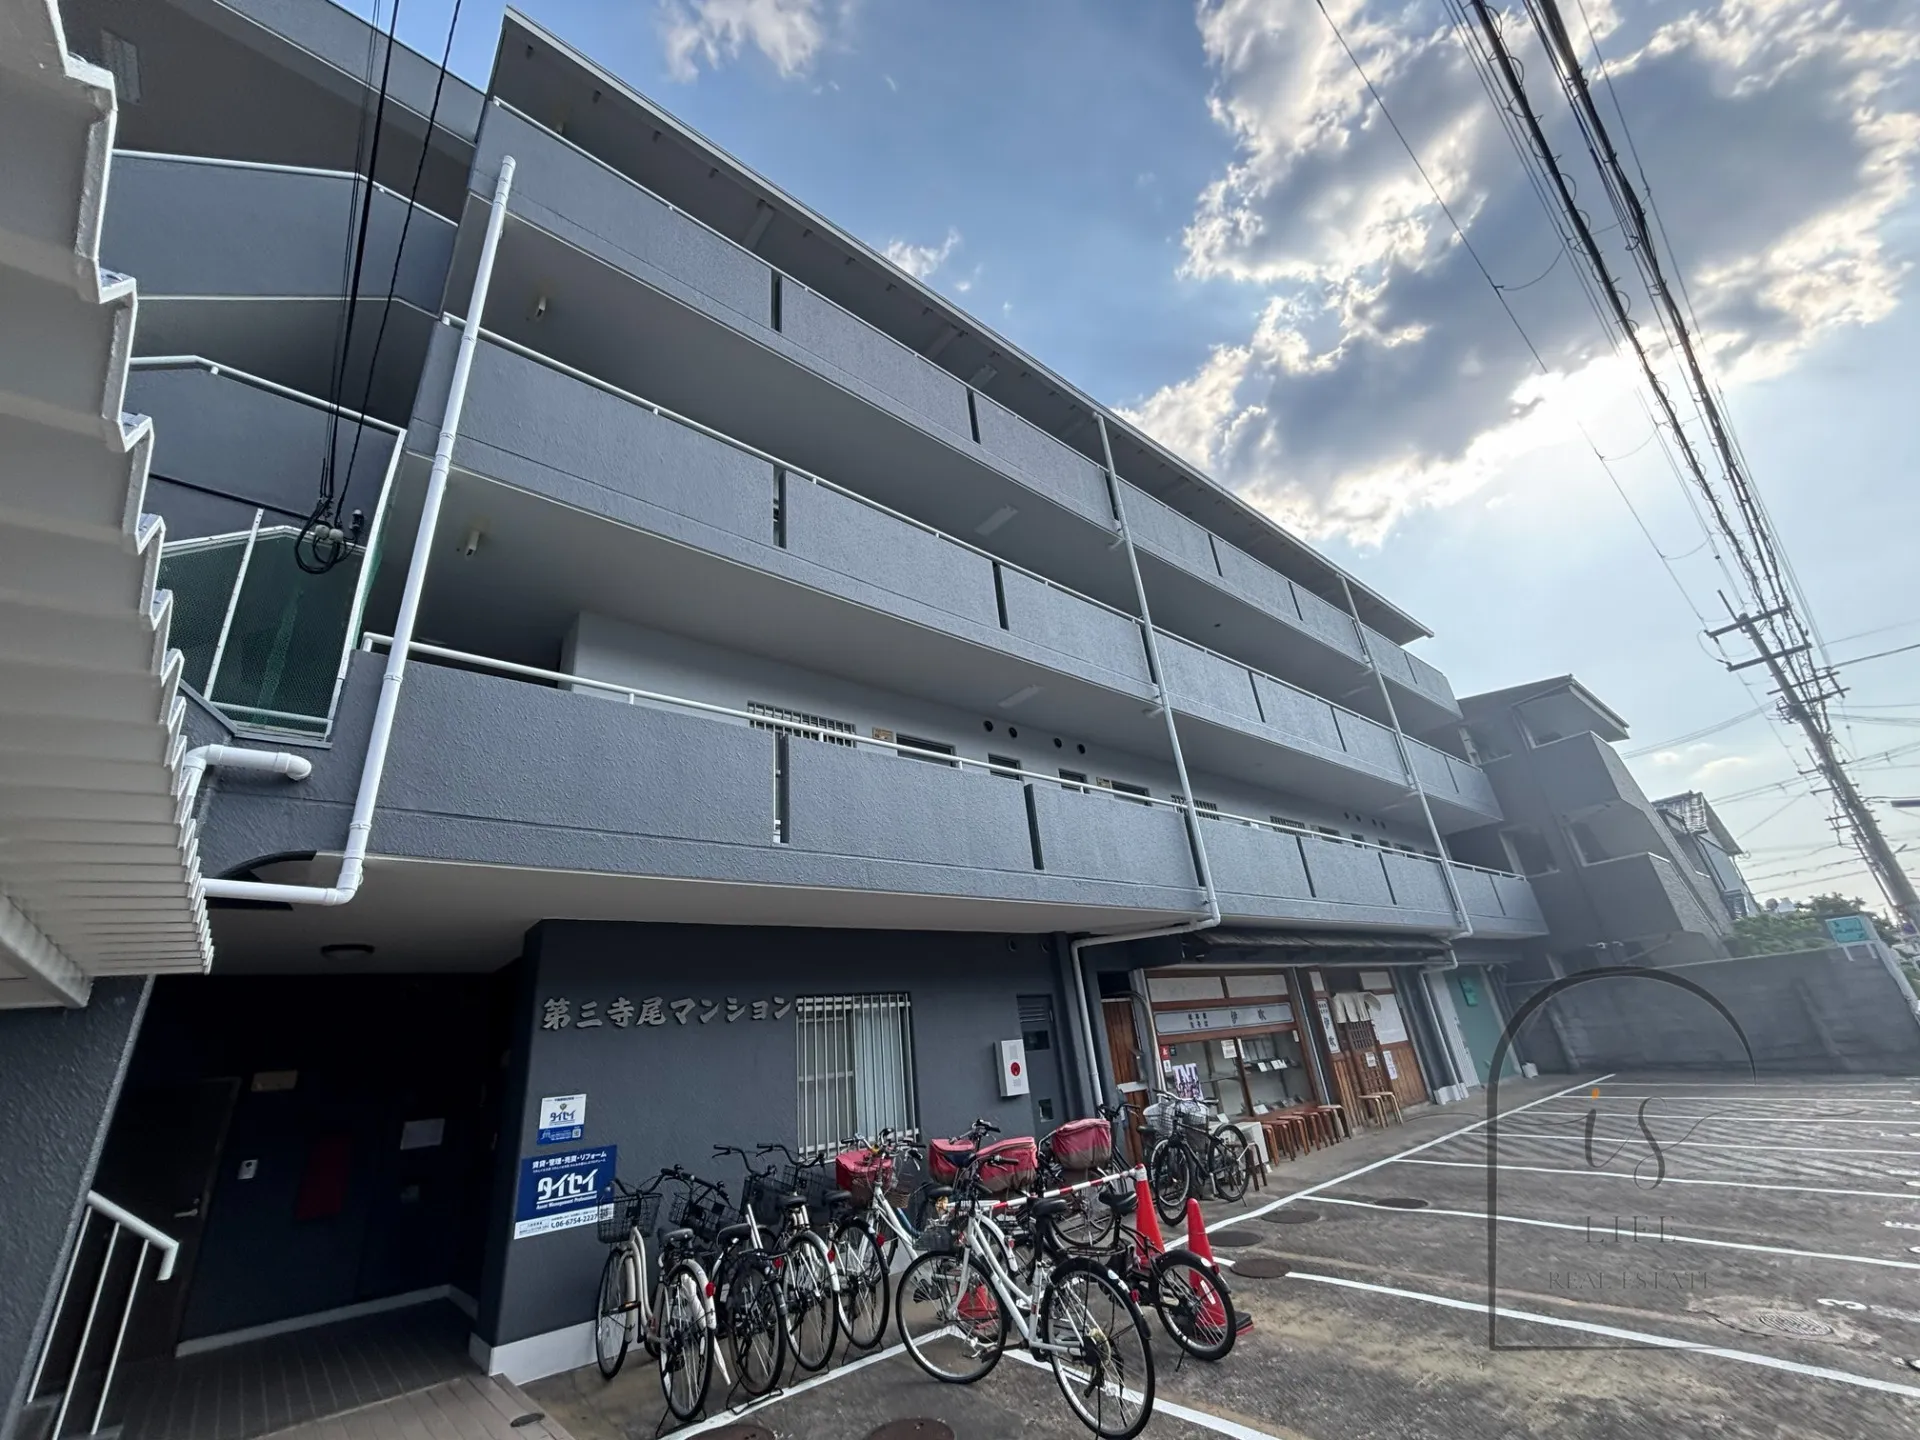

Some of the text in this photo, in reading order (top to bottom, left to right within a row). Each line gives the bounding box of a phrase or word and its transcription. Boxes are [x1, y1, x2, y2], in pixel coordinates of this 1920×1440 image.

[542, 996, 792, 1030] 第三寺尾マンション
[537, 1168, 599, 1201] タイセイ
